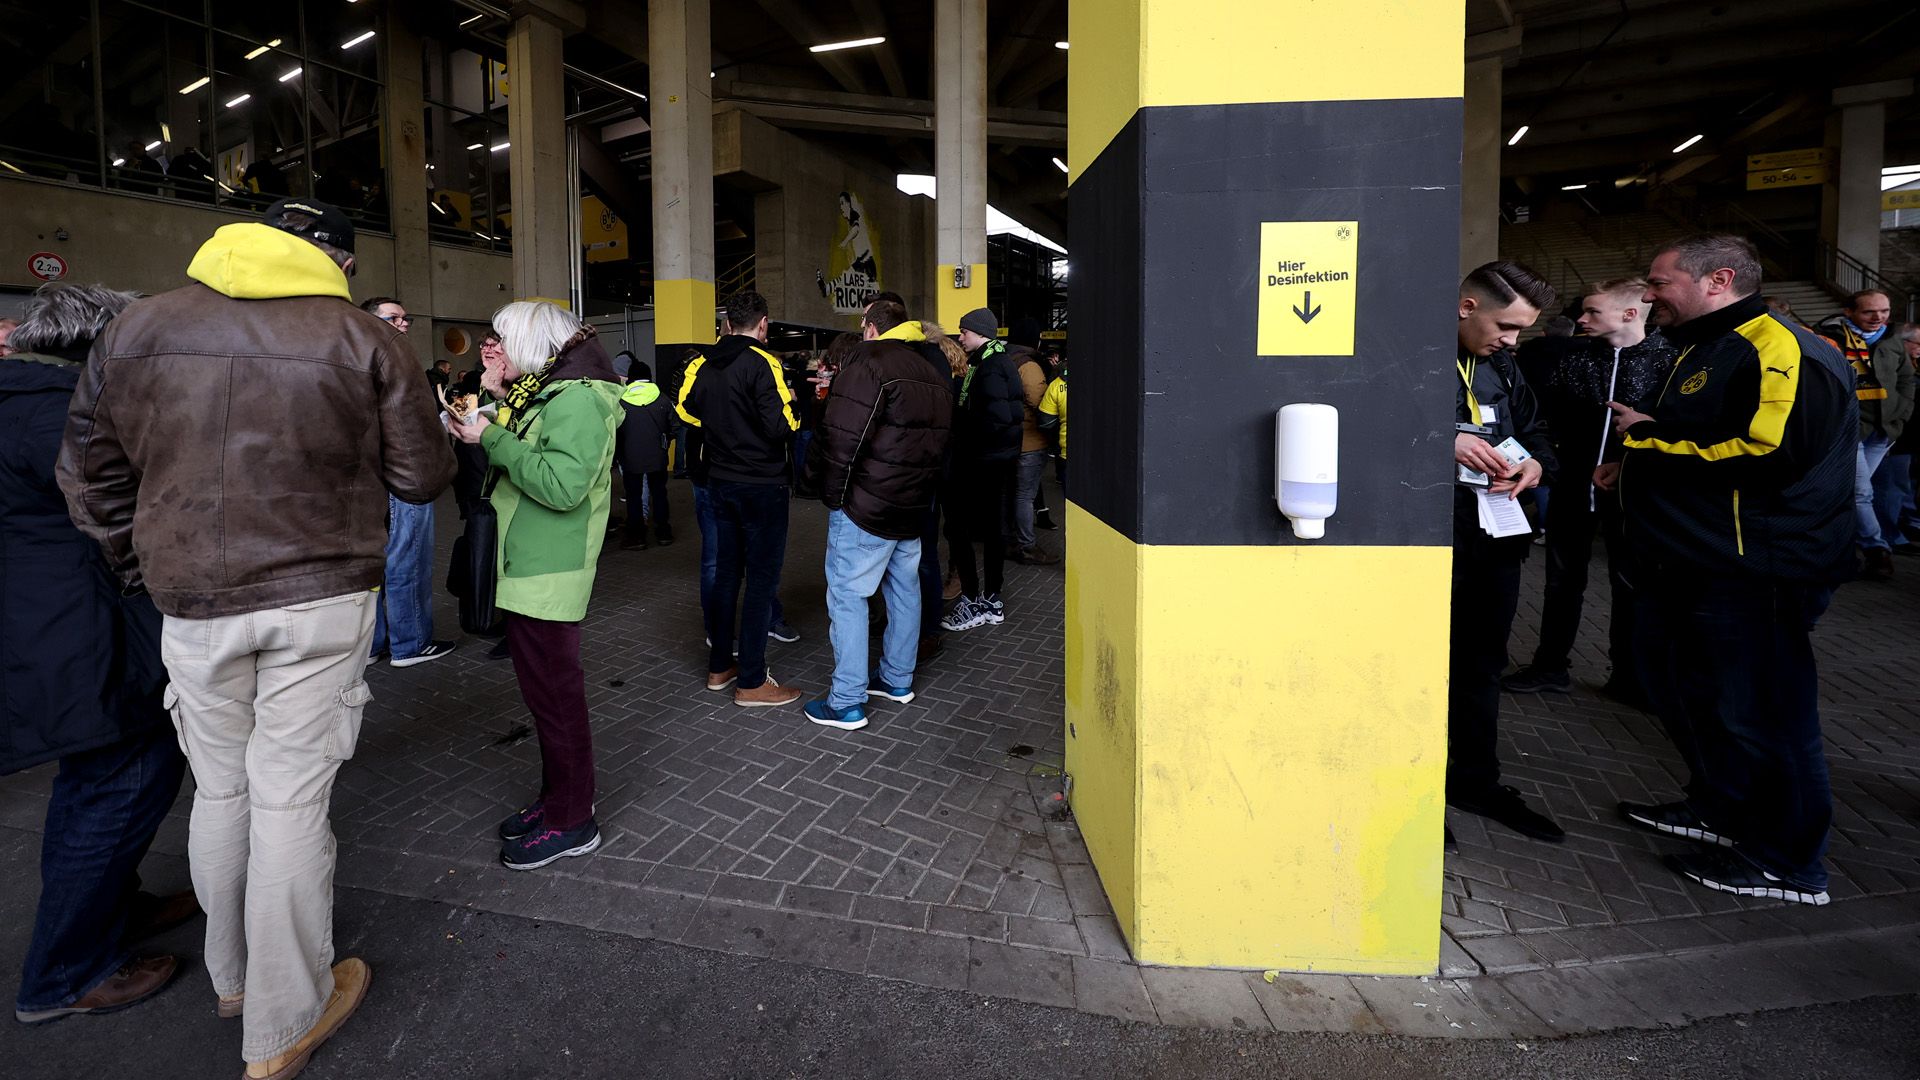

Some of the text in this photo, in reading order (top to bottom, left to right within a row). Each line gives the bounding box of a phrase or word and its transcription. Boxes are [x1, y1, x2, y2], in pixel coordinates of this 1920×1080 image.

[602, 208, 616, 225] BVB
[1337, 227, 1350, 237] BVB
[1278, 260, 1306, 273] Hier
[844, 273, 866, 287] LARS
[1267, 269, 1349, 287] Desinfektion
[1683, 372, 1704, 389] BVB
